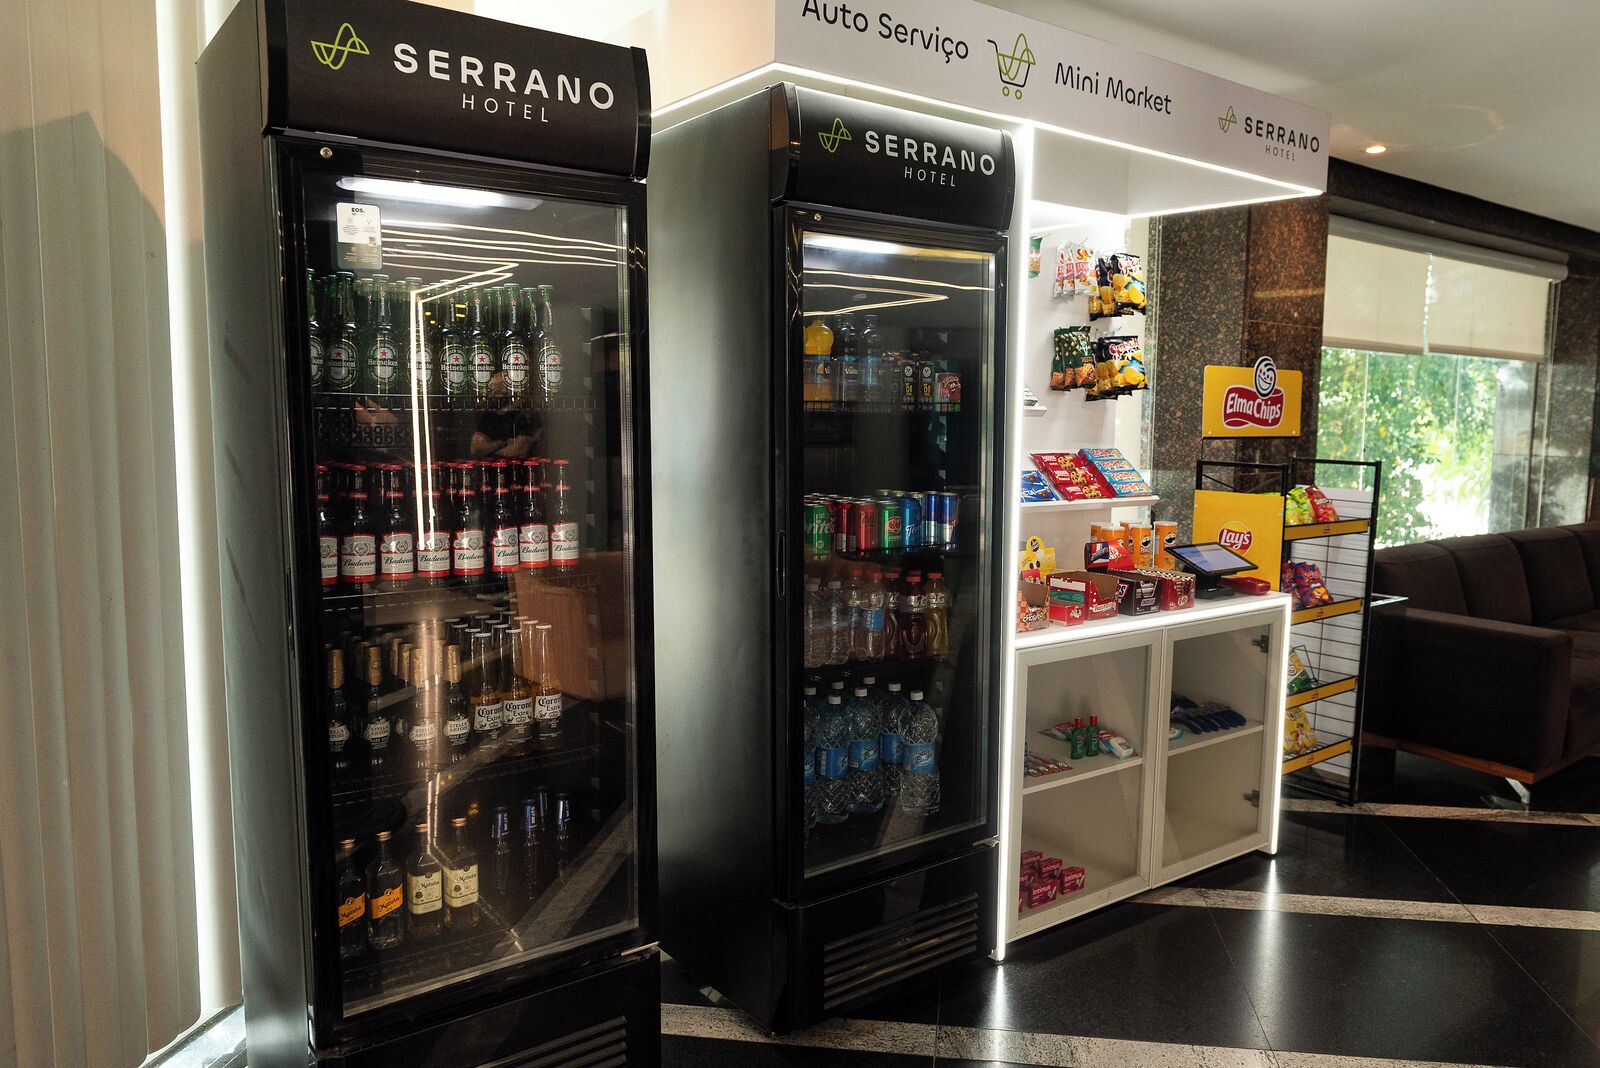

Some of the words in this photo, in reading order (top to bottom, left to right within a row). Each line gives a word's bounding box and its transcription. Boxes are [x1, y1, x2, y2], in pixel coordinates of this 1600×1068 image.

[802, 0, 869, 32] Auto
[878, 12, 969, 64] Serviço
[393, 42, 614, 110] SERRANO
[1056, 63, 1099, 95] Mini
[1105, 76, 1172, 115] Market
[462, 93, 550, 123] HOTEL
[865, 129, 996, 177] SERRANO
[1244, 116, 1320, 153] SERRANO
[1265, 145, 1296, 161] HOTEL
[904, 166, 957, 188] HOTEL
[1221, 528, 1251, 550] Lay's
